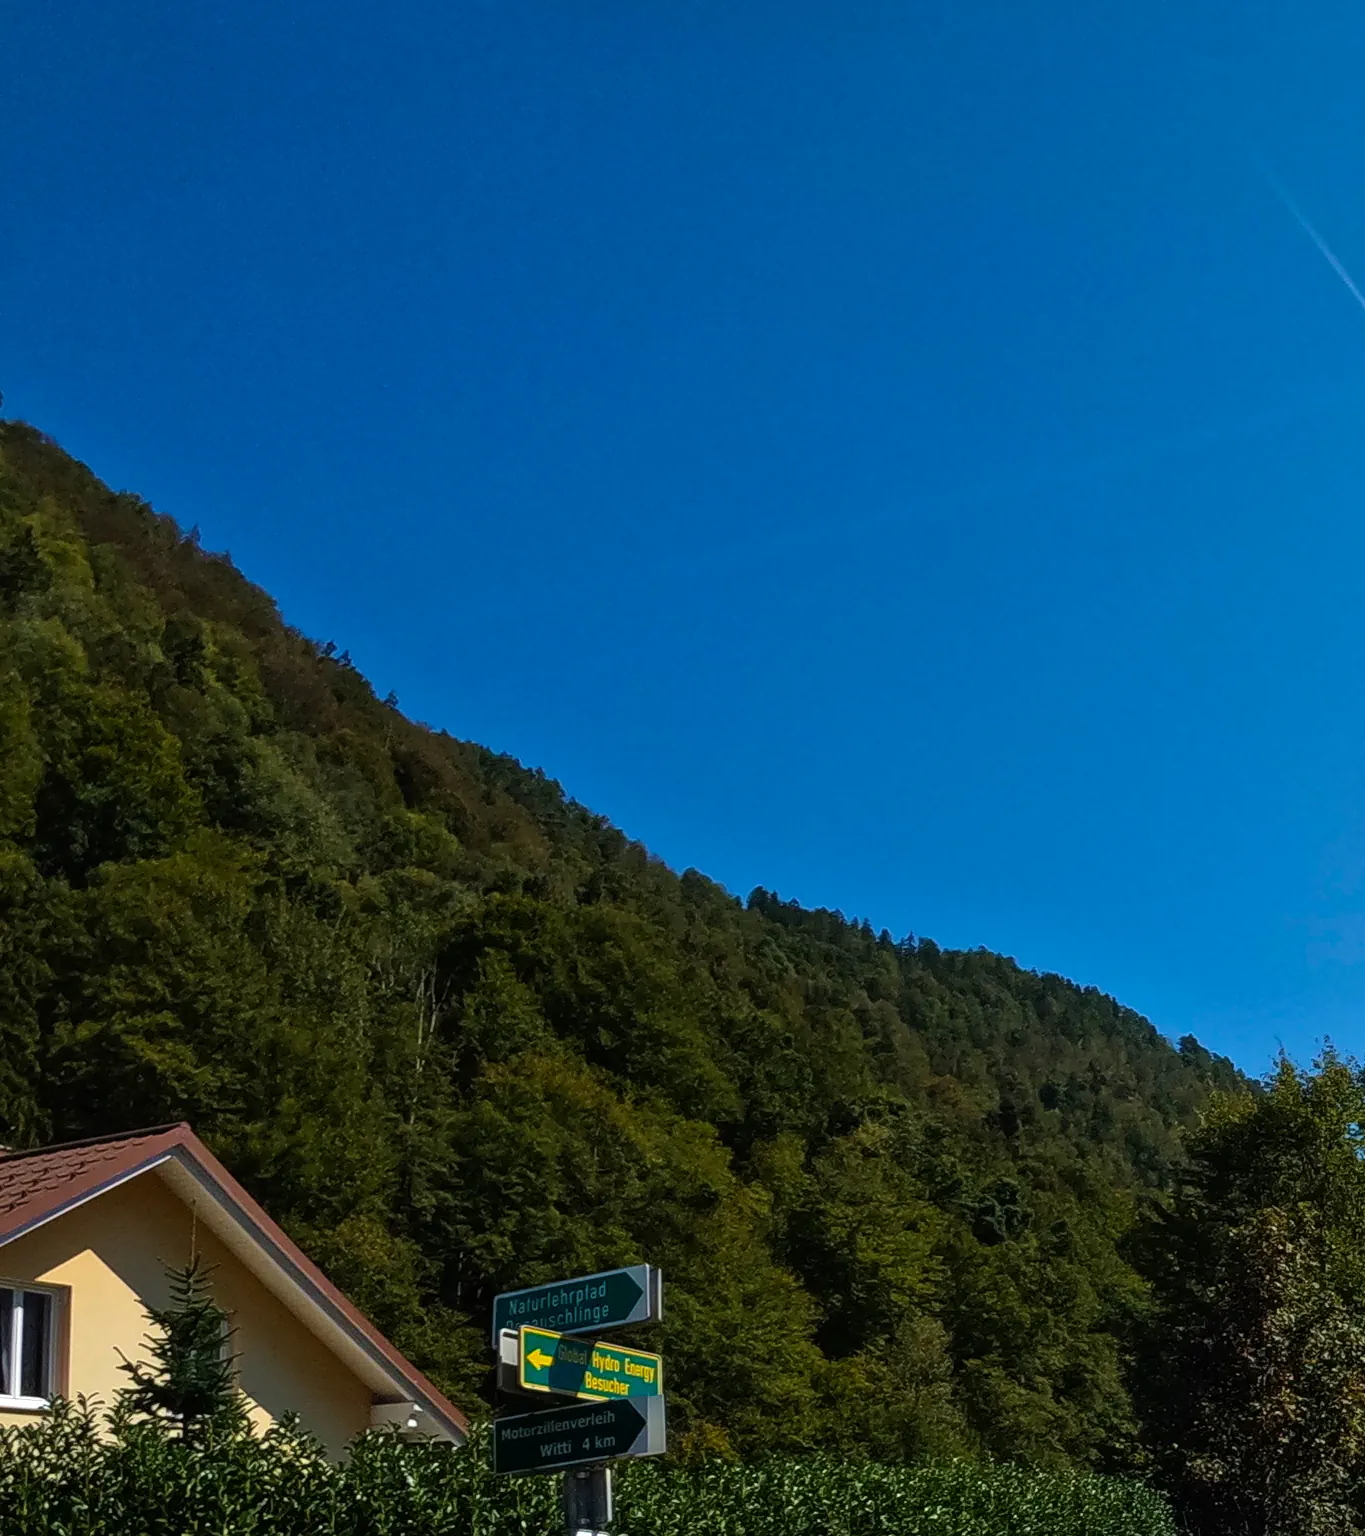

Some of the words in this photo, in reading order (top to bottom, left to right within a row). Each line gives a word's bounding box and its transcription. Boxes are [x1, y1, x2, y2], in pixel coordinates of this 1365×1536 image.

[558, 1344, 588, 1365] Global
[592, 1350, 620, 1373] Hydro
[625, 1357, 655, 1384] Energy
[584, 1370, 630, 1395] Besucher
[540, 1440, 572, 1457] Witti
[582, 1437, 590, 1450] 4
[595, 1435, 616, 1449] km
